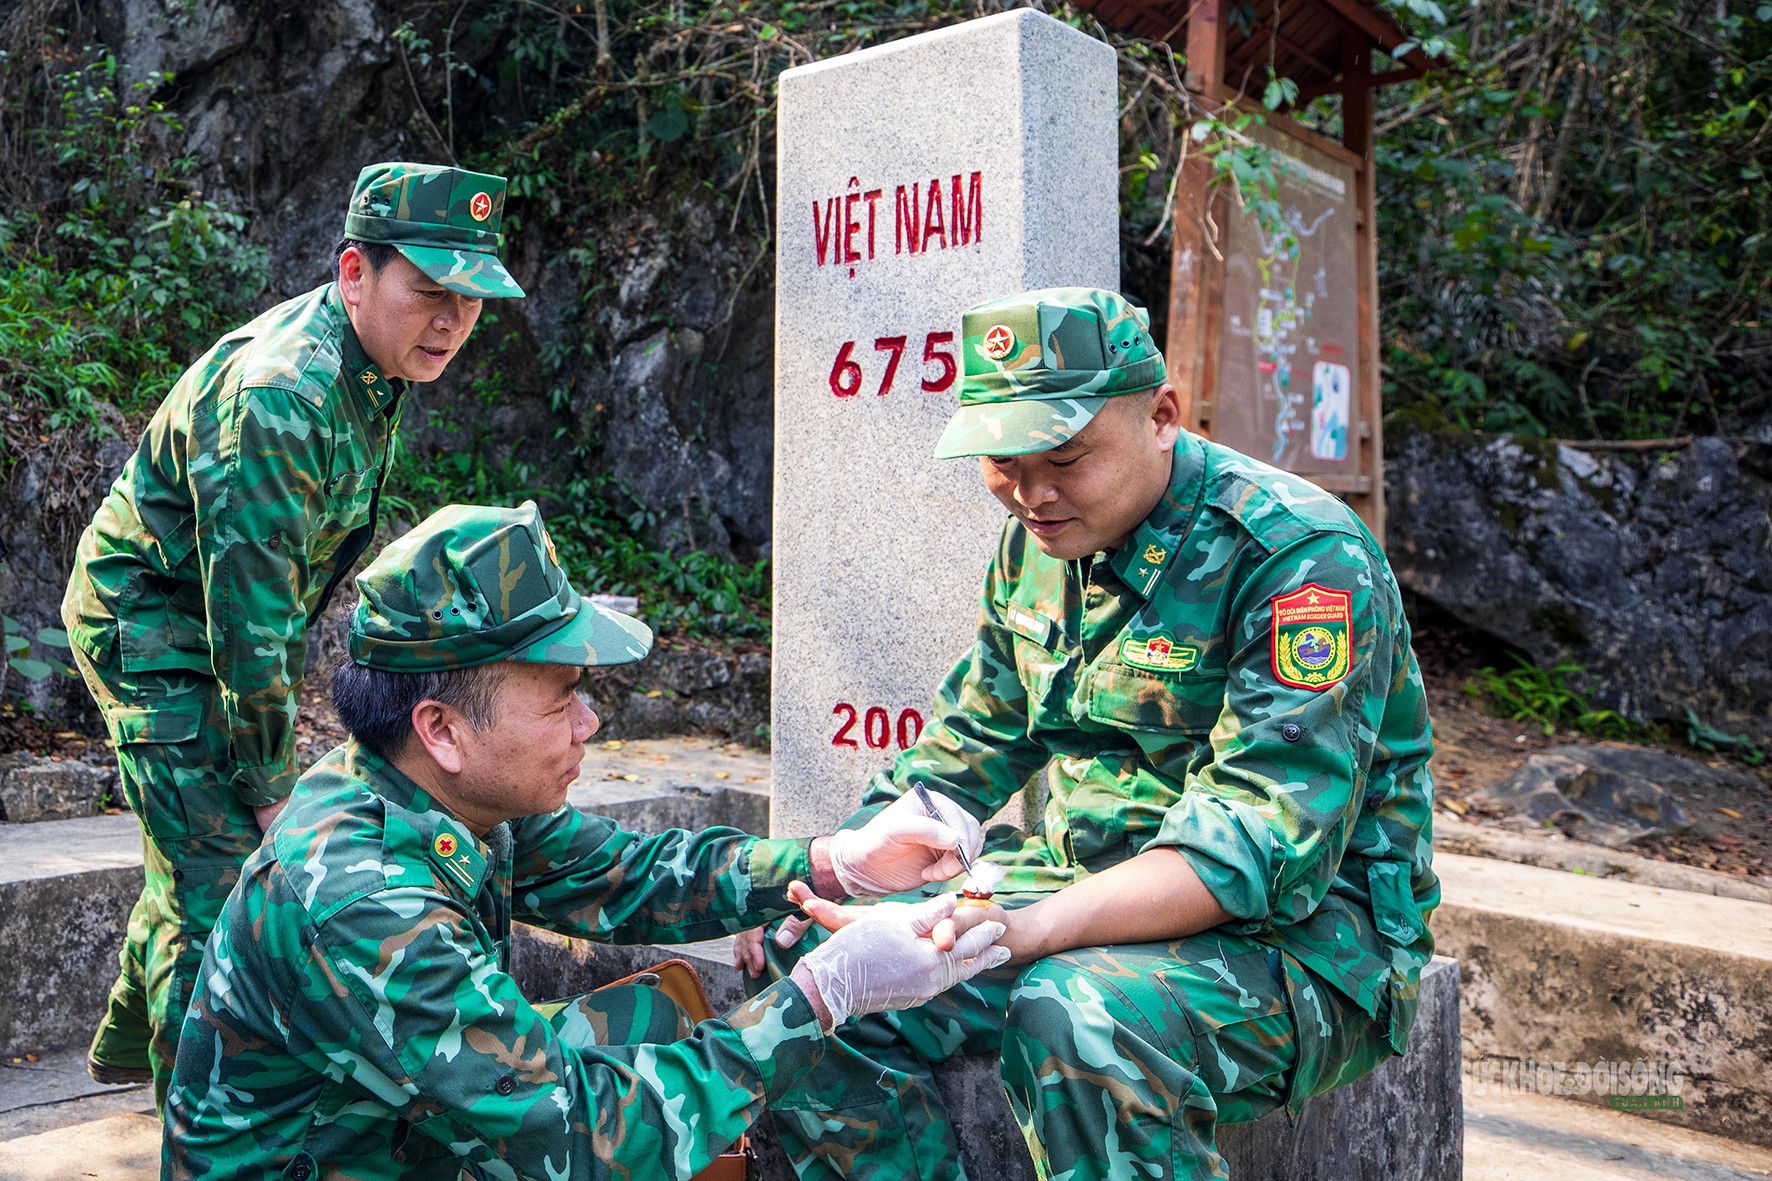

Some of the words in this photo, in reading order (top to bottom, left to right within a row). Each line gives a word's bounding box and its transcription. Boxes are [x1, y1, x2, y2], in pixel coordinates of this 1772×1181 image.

[813, 175, 883, 280] VIỆT
[895, 171, 983, 258] NAM
[828, 331, 958, 402] 675
